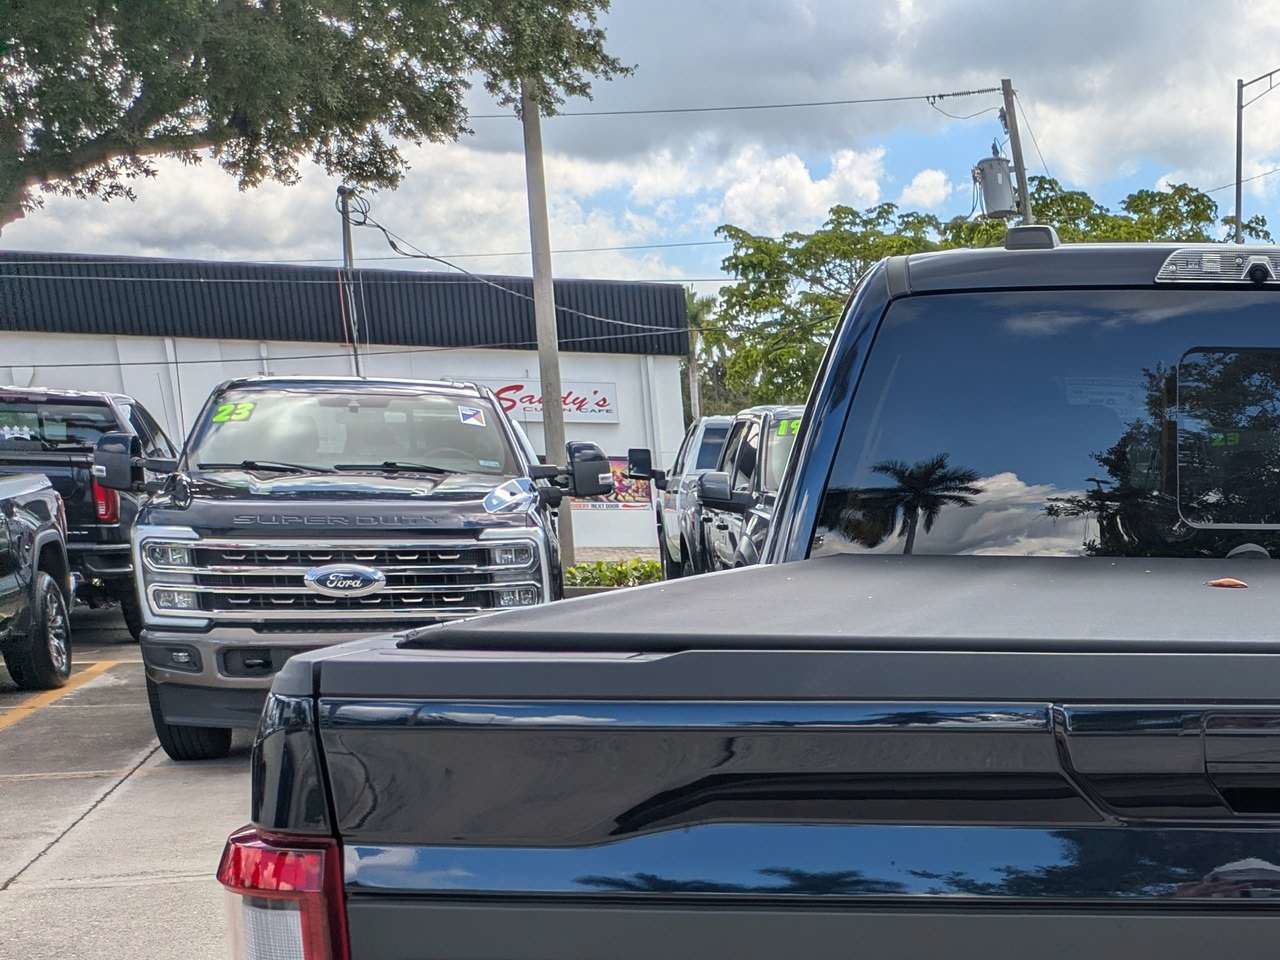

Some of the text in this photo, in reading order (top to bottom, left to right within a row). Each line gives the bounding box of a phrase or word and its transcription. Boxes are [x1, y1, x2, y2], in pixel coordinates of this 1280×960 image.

[495, 384, 610, 414] Sady's
[213, 403, 255, 422] 23
[233, 514, 442, 527] SUPER DUTY
[326, 573, 363, 588] Ford
